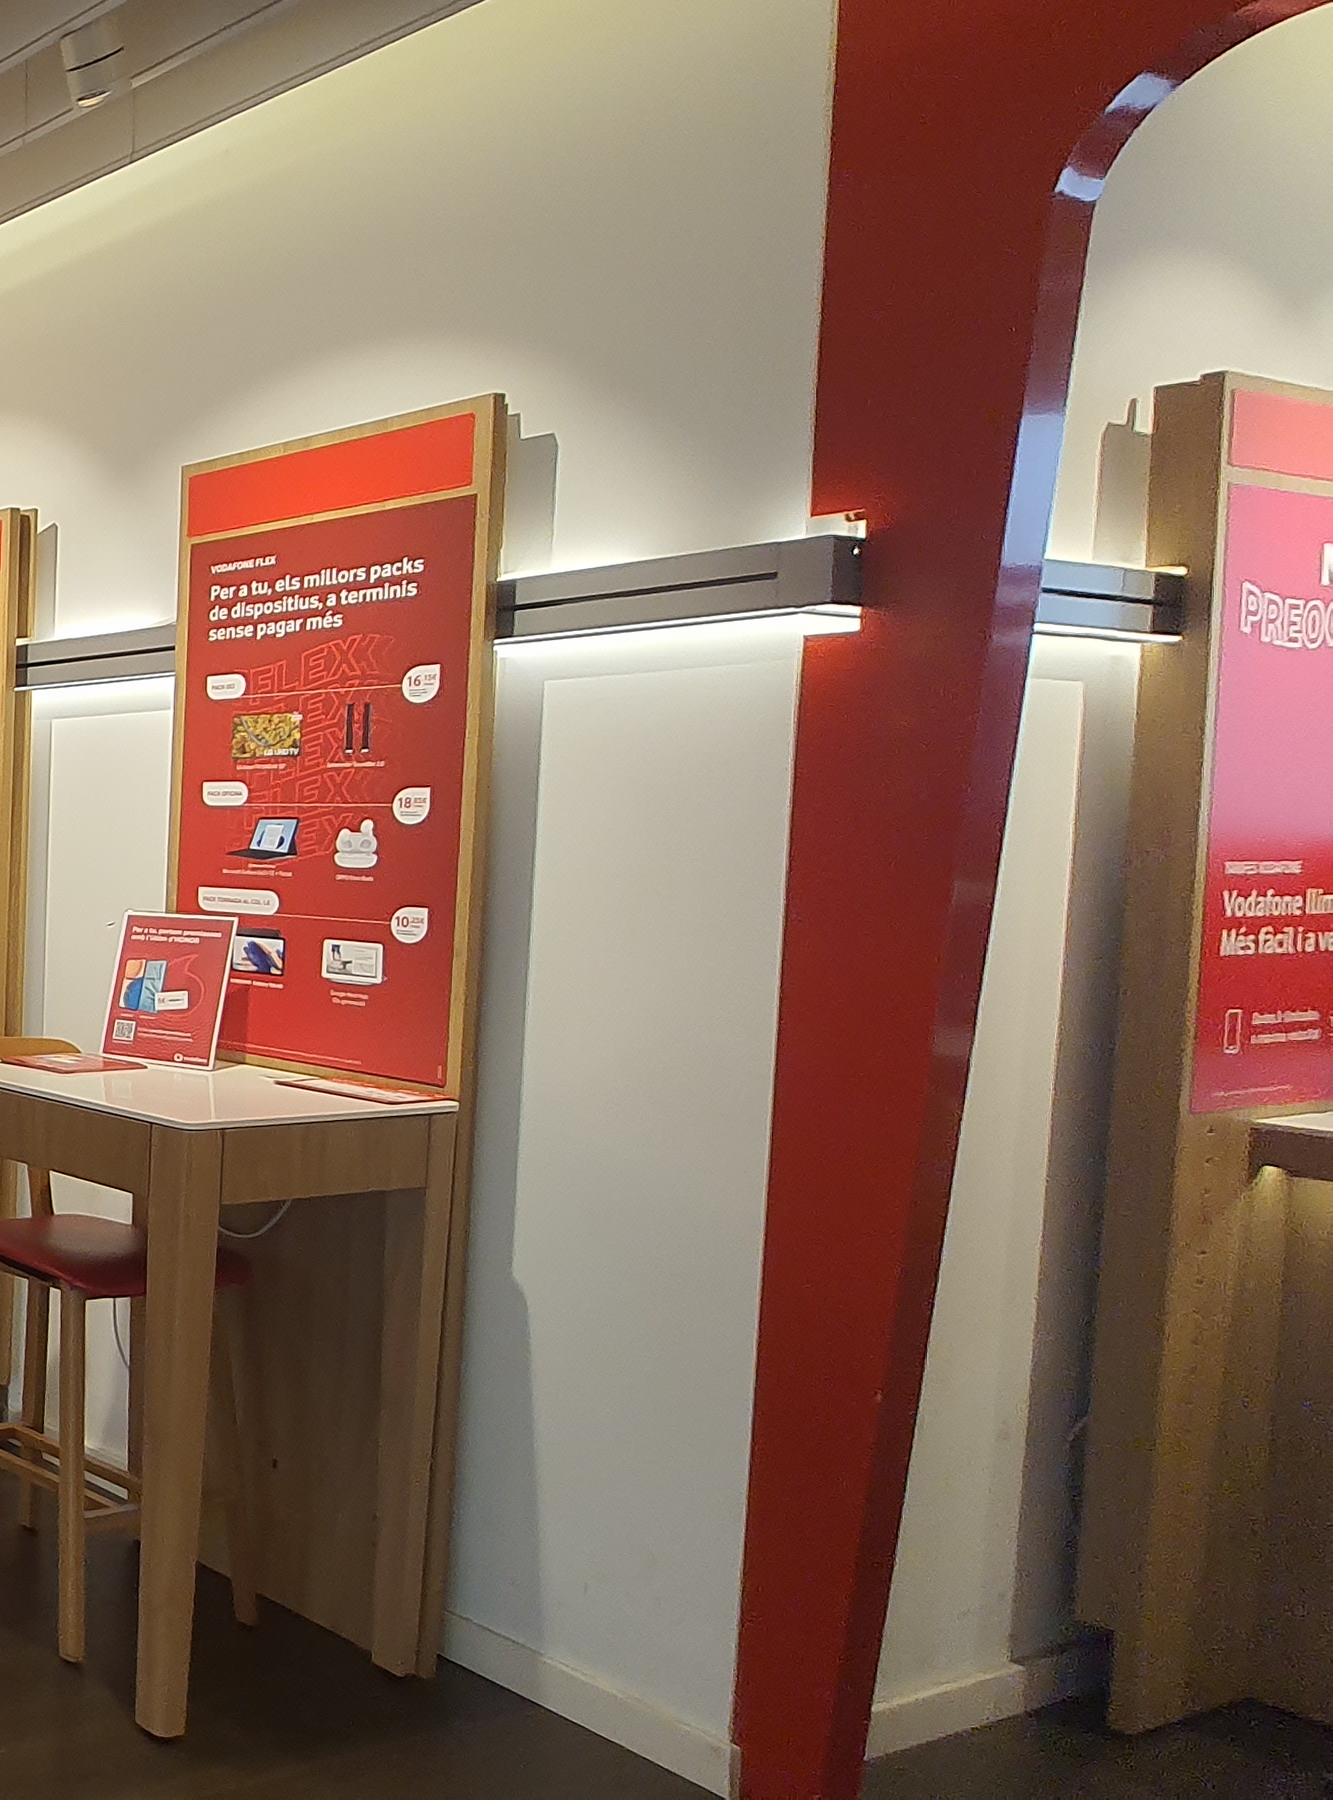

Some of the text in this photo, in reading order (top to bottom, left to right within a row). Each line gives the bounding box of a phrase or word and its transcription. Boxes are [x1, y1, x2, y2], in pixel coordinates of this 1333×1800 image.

[210, 557, 425, 601] Per a tu, els millors packs
[211, 555, 277, 574] VODAFONE FLEX
[209, 580, 418, 621] de dispositius, a terminis
[208, 611, 343, 642] sense pagar més
[249, 635, 362, 705] FLEX
[407, 674, 421, 687] 16
[397, 797, 412, 808] 18
[1223, 888, 1303, 917] Vodafone
[395, 916, 410, 928] 10
[1220, 926, 1256, 957] Més
[1296, 926, 1304, 952] i
[1304, 931, 1317, 953] a
